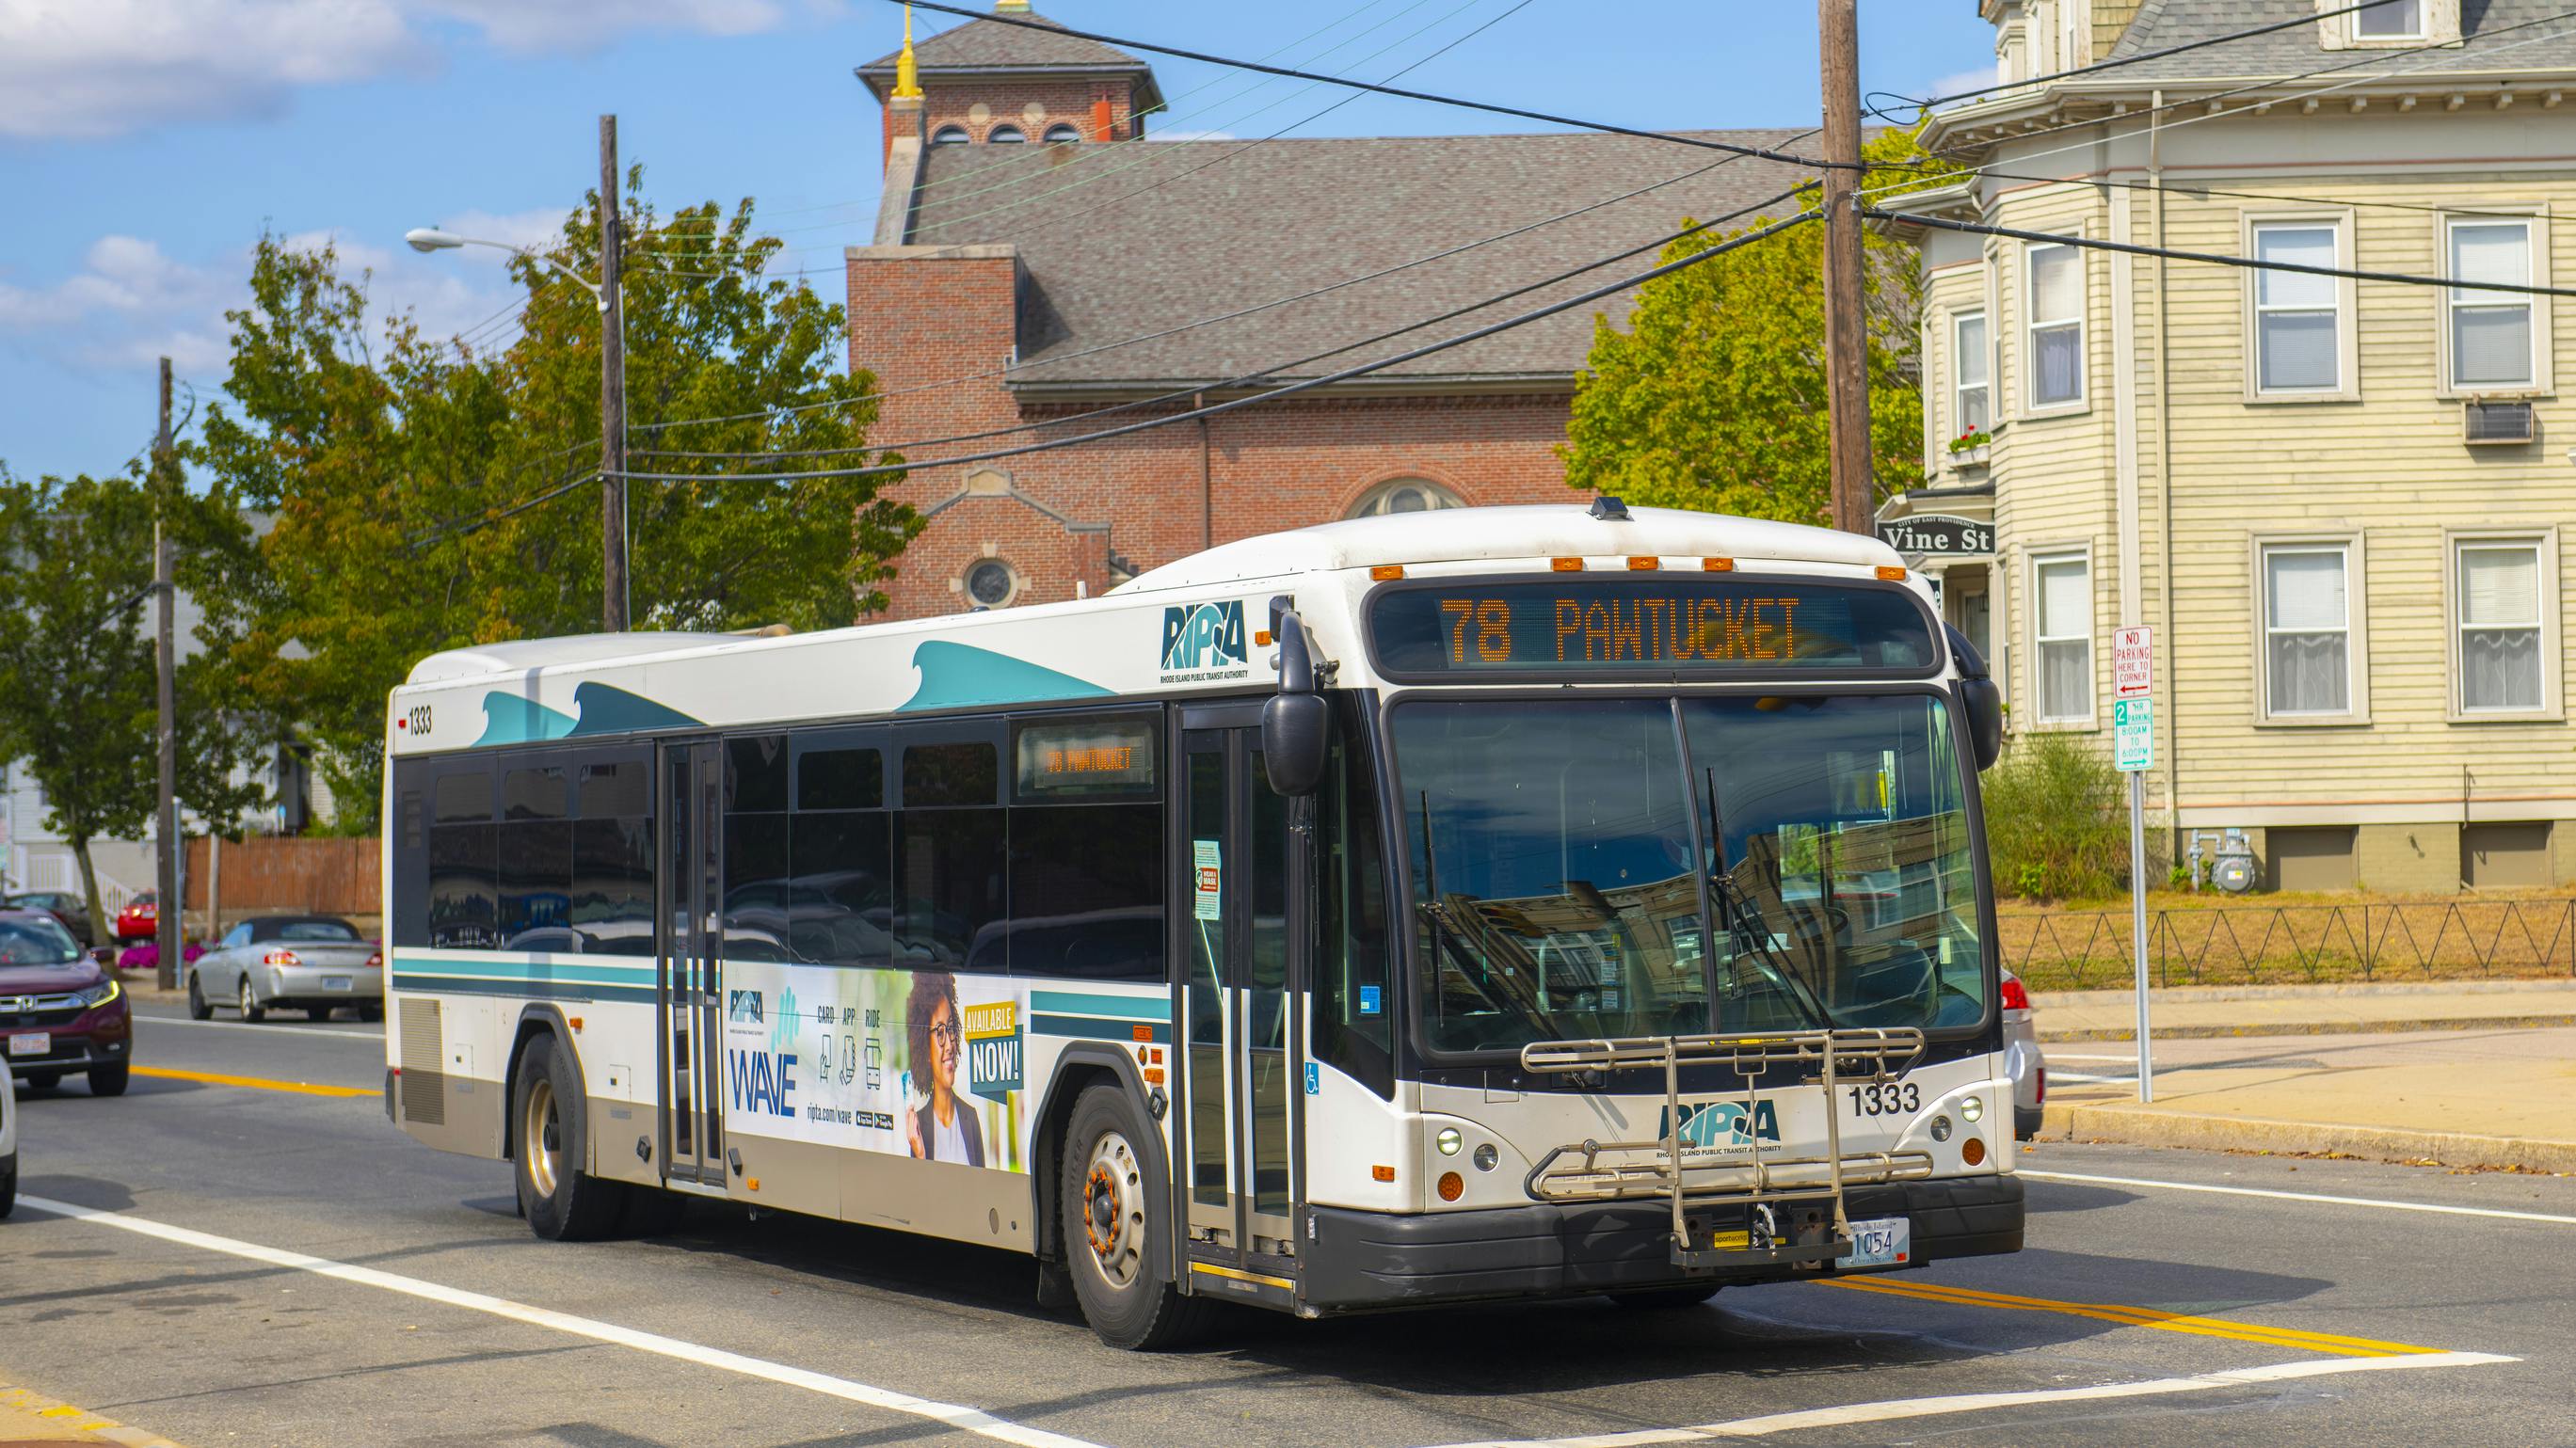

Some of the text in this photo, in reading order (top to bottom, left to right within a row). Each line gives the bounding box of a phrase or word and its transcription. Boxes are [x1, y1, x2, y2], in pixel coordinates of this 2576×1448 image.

[1938, 517, 1976, 529] PROVIDENCE
[1884, 527, 1990, 550] Vine St
[1160, 599, 1248, 670] RIPTA
[1441, 597, 1800, 662] 78 PAWTUCKET
[2125, 631, 2139, 645] NO
[2117, 646, 2149, 661] PARKING
[1160, 669, 1248, 684] RHODE ISLAND PUBLIC TRANSIT AUTHORITY
[2118, 661, 2148, 672] HERE TO
[2120, 672, 2147, 683] CORNER
[409, 705, 432, 736] 1333
[2117, 702, 2143, 722] 2 HR
[2127, 713, 2152, 722] PARKING
[2122, 725, 2147, 736] 8:00AM
[2122, 747, 2148, 757] 6:00PM
[2131, 738, 2139, 746] TO
[818, 1005, 881, 1028] CARD APP RIDE
[966, 1007, 1012, 1033] AVAILABLE
[972, 1041, 1019, 1083] NOW!
[729, 1048, 798, 1118] WAVE
[1848, 1082, 1920, 1117] 1333
[808, 1102, 852, 1124] ripta.com/wave
[1658, 1099, 1782, 1147] RIPTA
[1748, 1145, 1782, 1154] ATHORITY
[1715, 1233, 1748, 1244] sportworks
[1855, 1231, 1892, 1255] 1054
